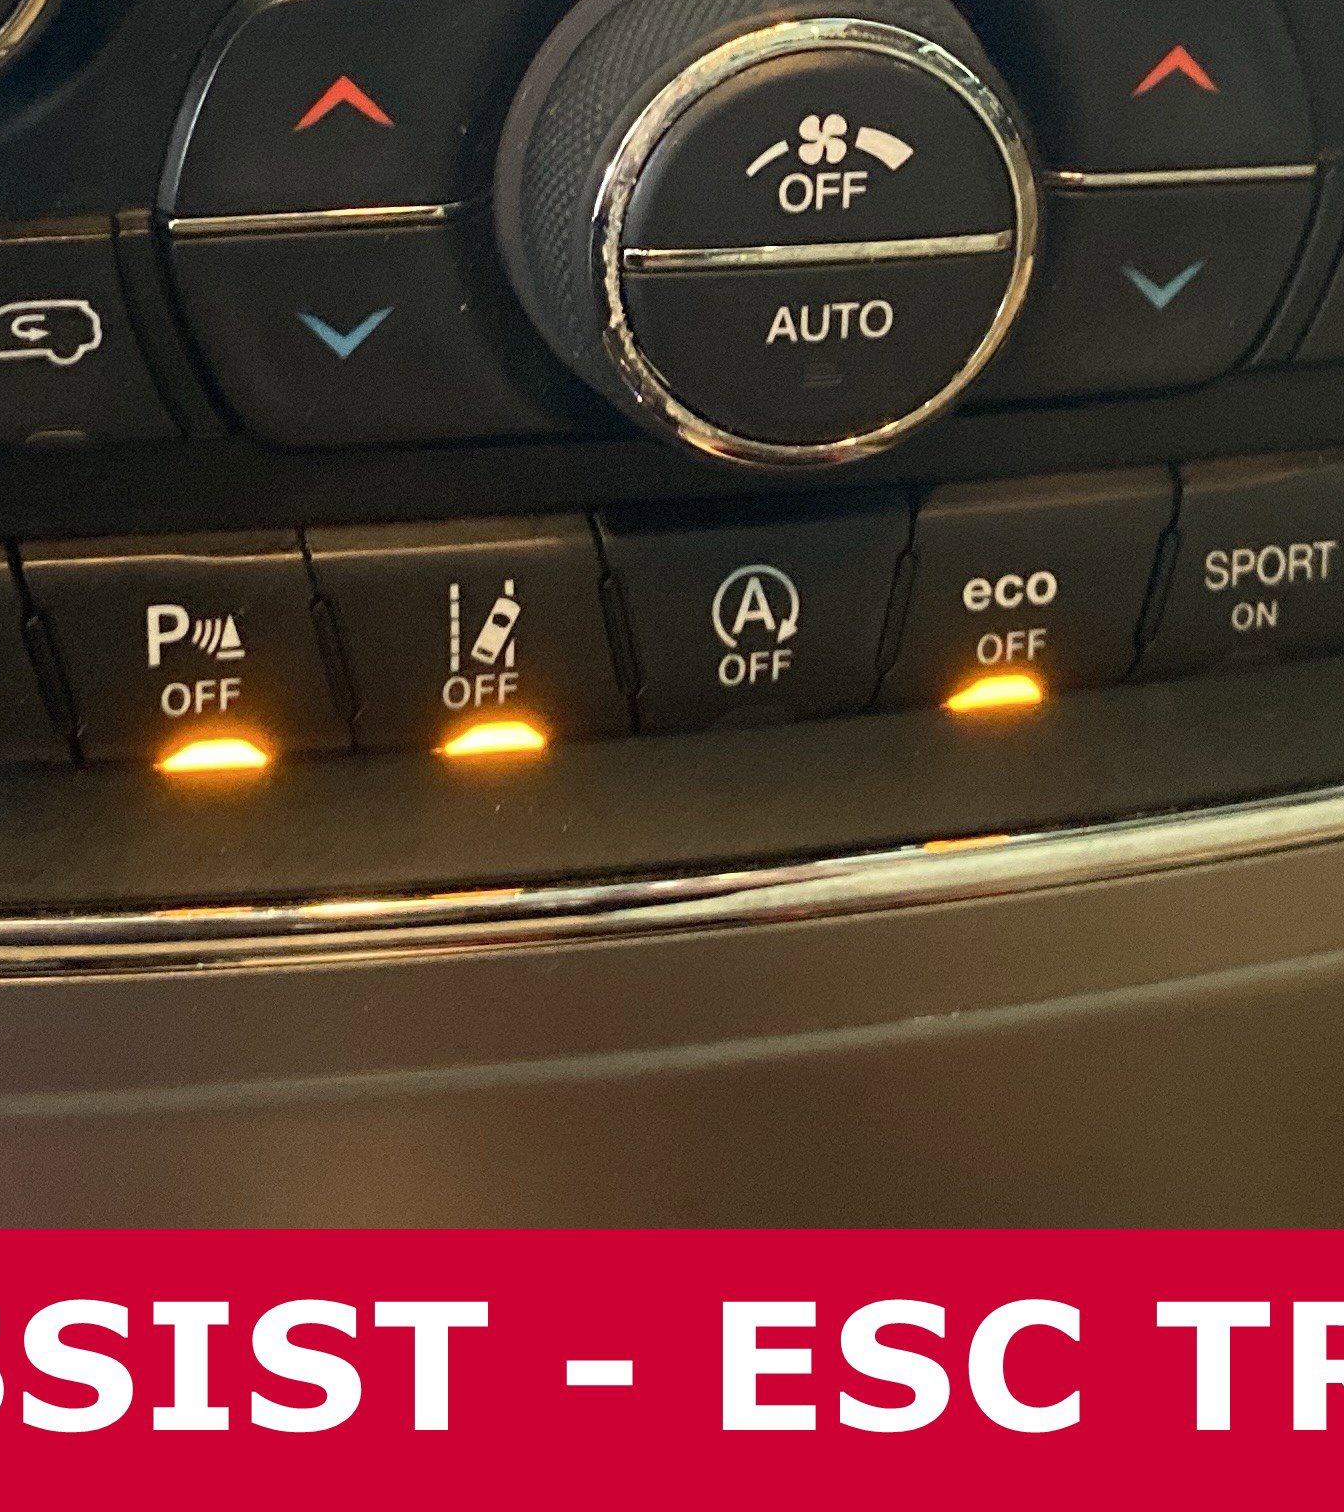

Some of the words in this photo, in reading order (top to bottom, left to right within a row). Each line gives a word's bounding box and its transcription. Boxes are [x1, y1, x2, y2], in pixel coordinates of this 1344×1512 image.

[778, 171, 869, 213] OFF
[766, 299, 894, 345] AUTO
[1204, 541, 1339, 591] SPORT
[962, 571, 1057, 612] eco
[147, 604, 190, 667] P
[1230, 602, 1278, 631] ON
[976, 629, 1047, 666] OFF
[717, 649, 793, 687] OFF
[161, 678, 242, 718] OFF
[442, 672, 519, 709] OFF
